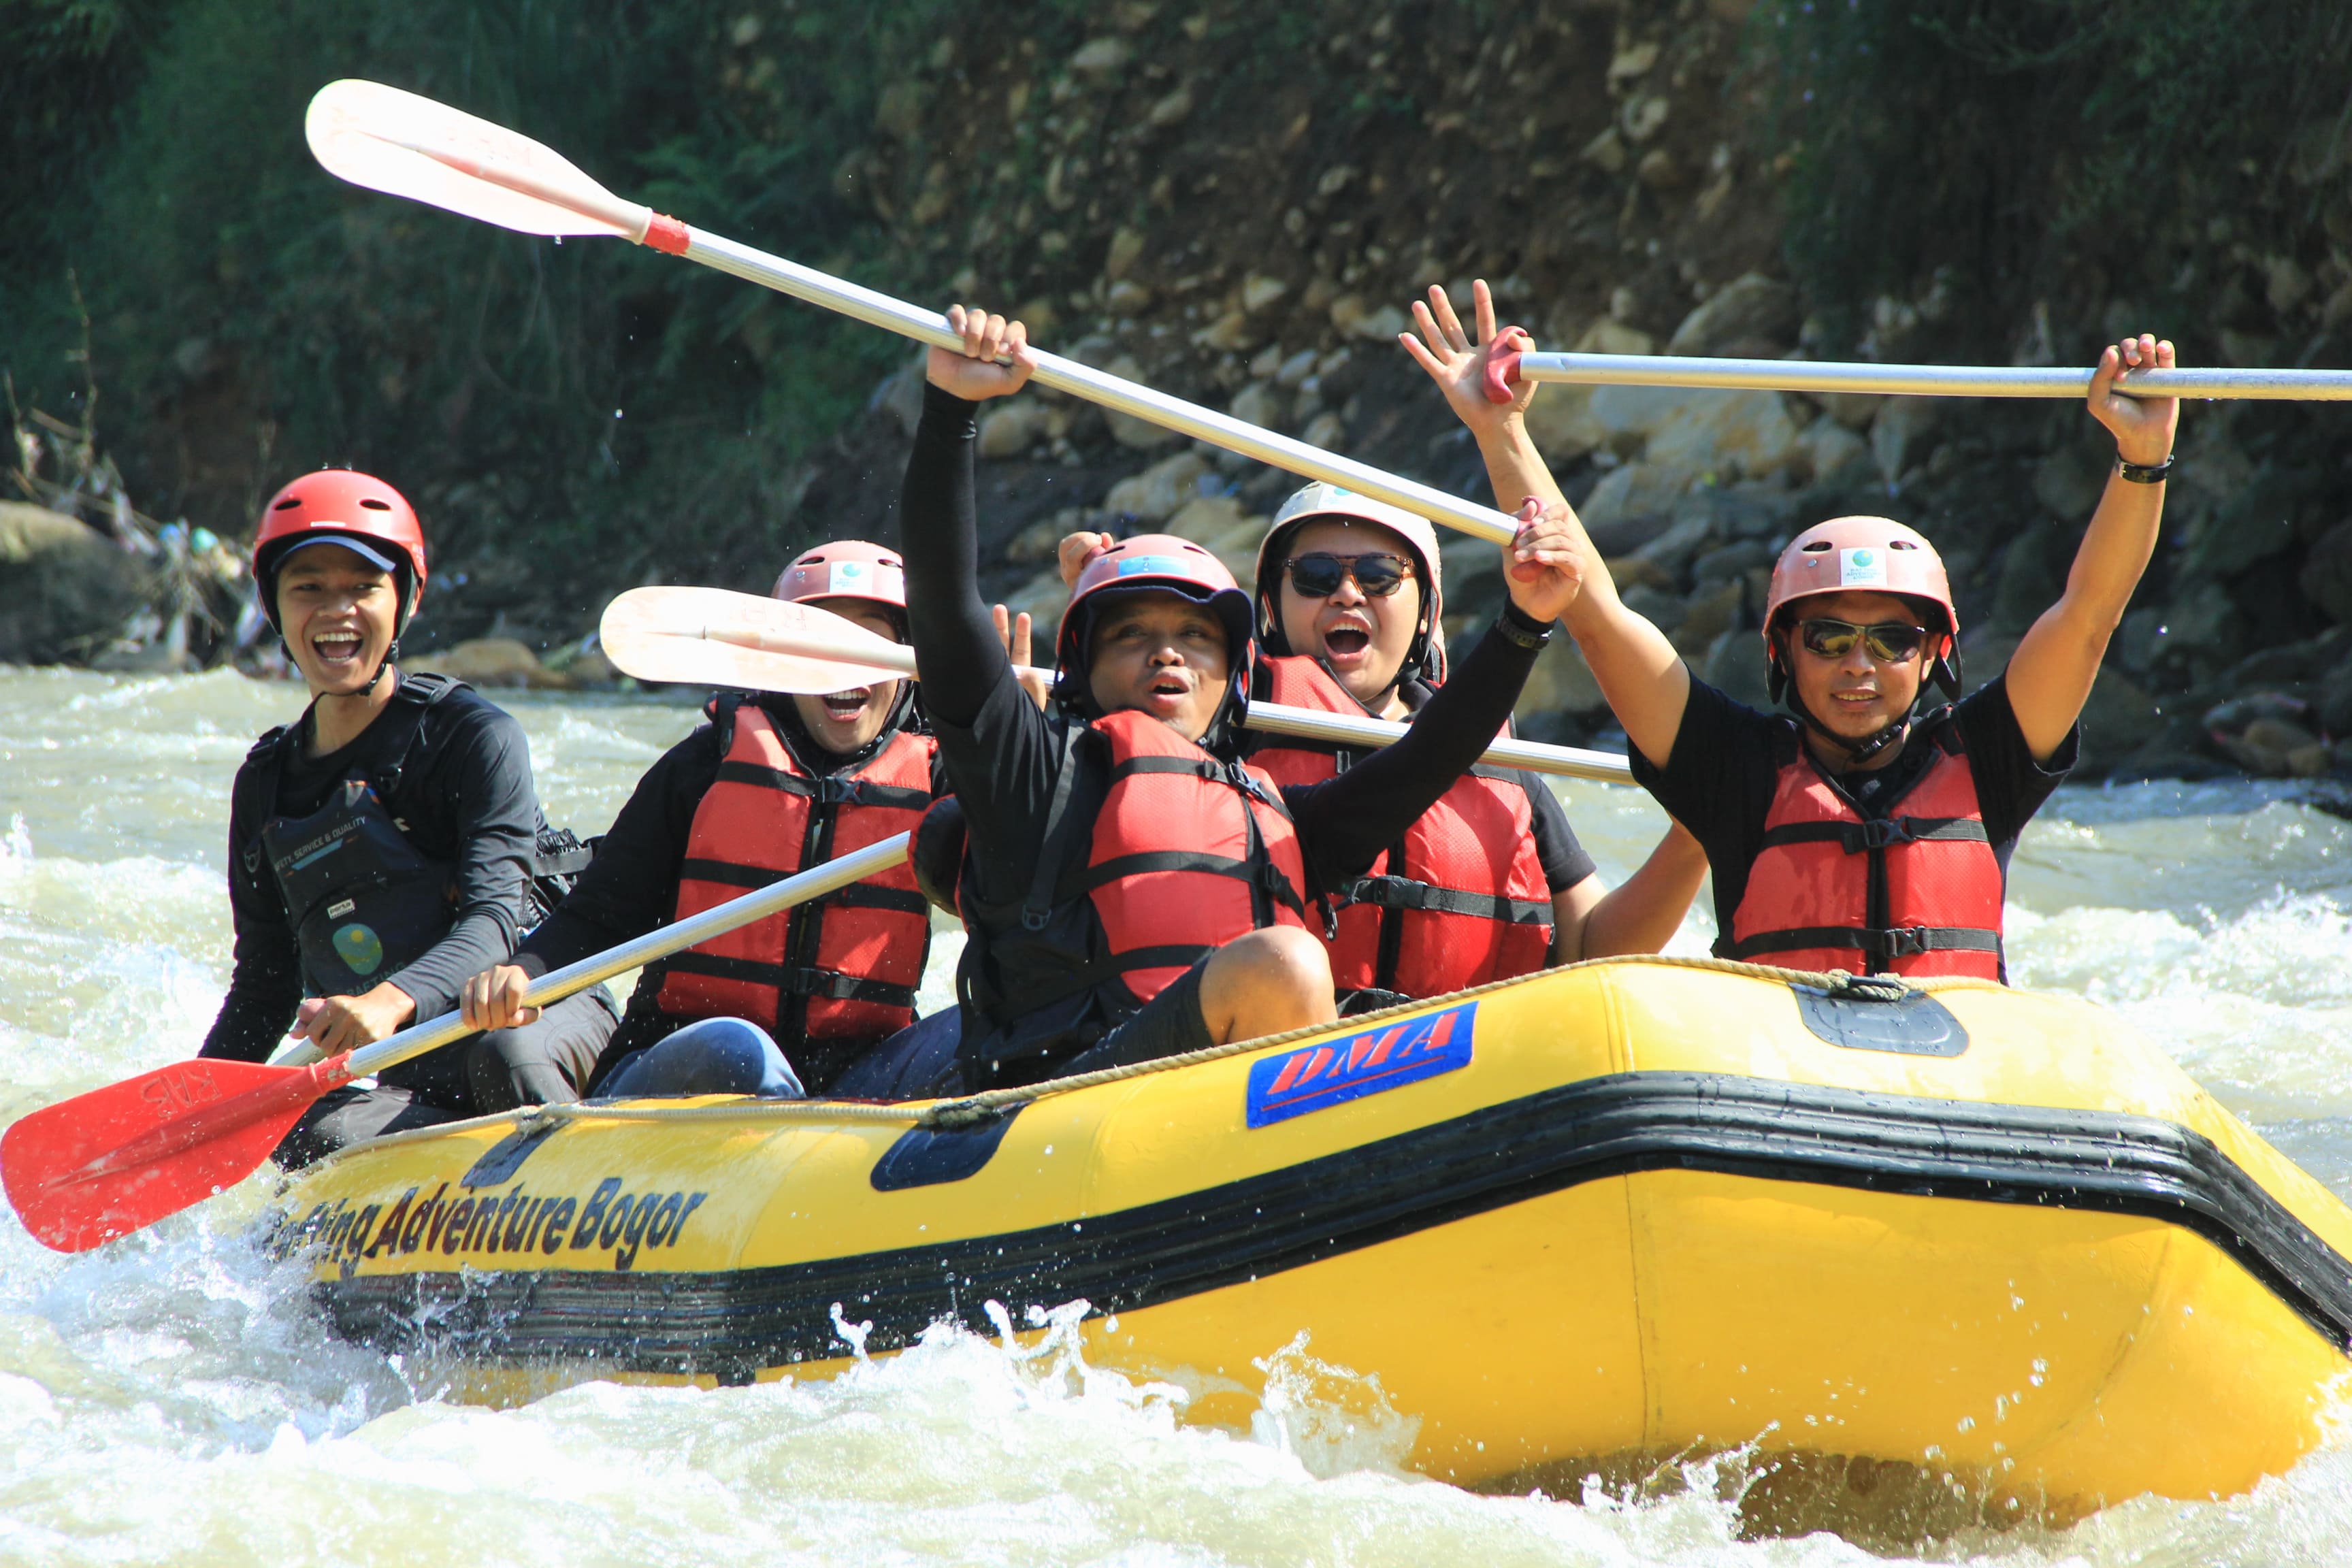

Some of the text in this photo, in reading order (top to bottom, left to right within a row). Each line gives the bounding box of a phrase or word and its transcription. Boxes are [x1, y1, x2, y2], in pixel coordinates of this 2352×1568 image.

[293, 836, 324, 860] SERVICE
[324, 832, 331, 843] &
[331, 816, 366, 838] QUALITY
[1267, 1011, 1460, 1095] DMA
[362, 1181, 578, 1258] Adventure
[569, 1177, 708, 1271] Bogor
